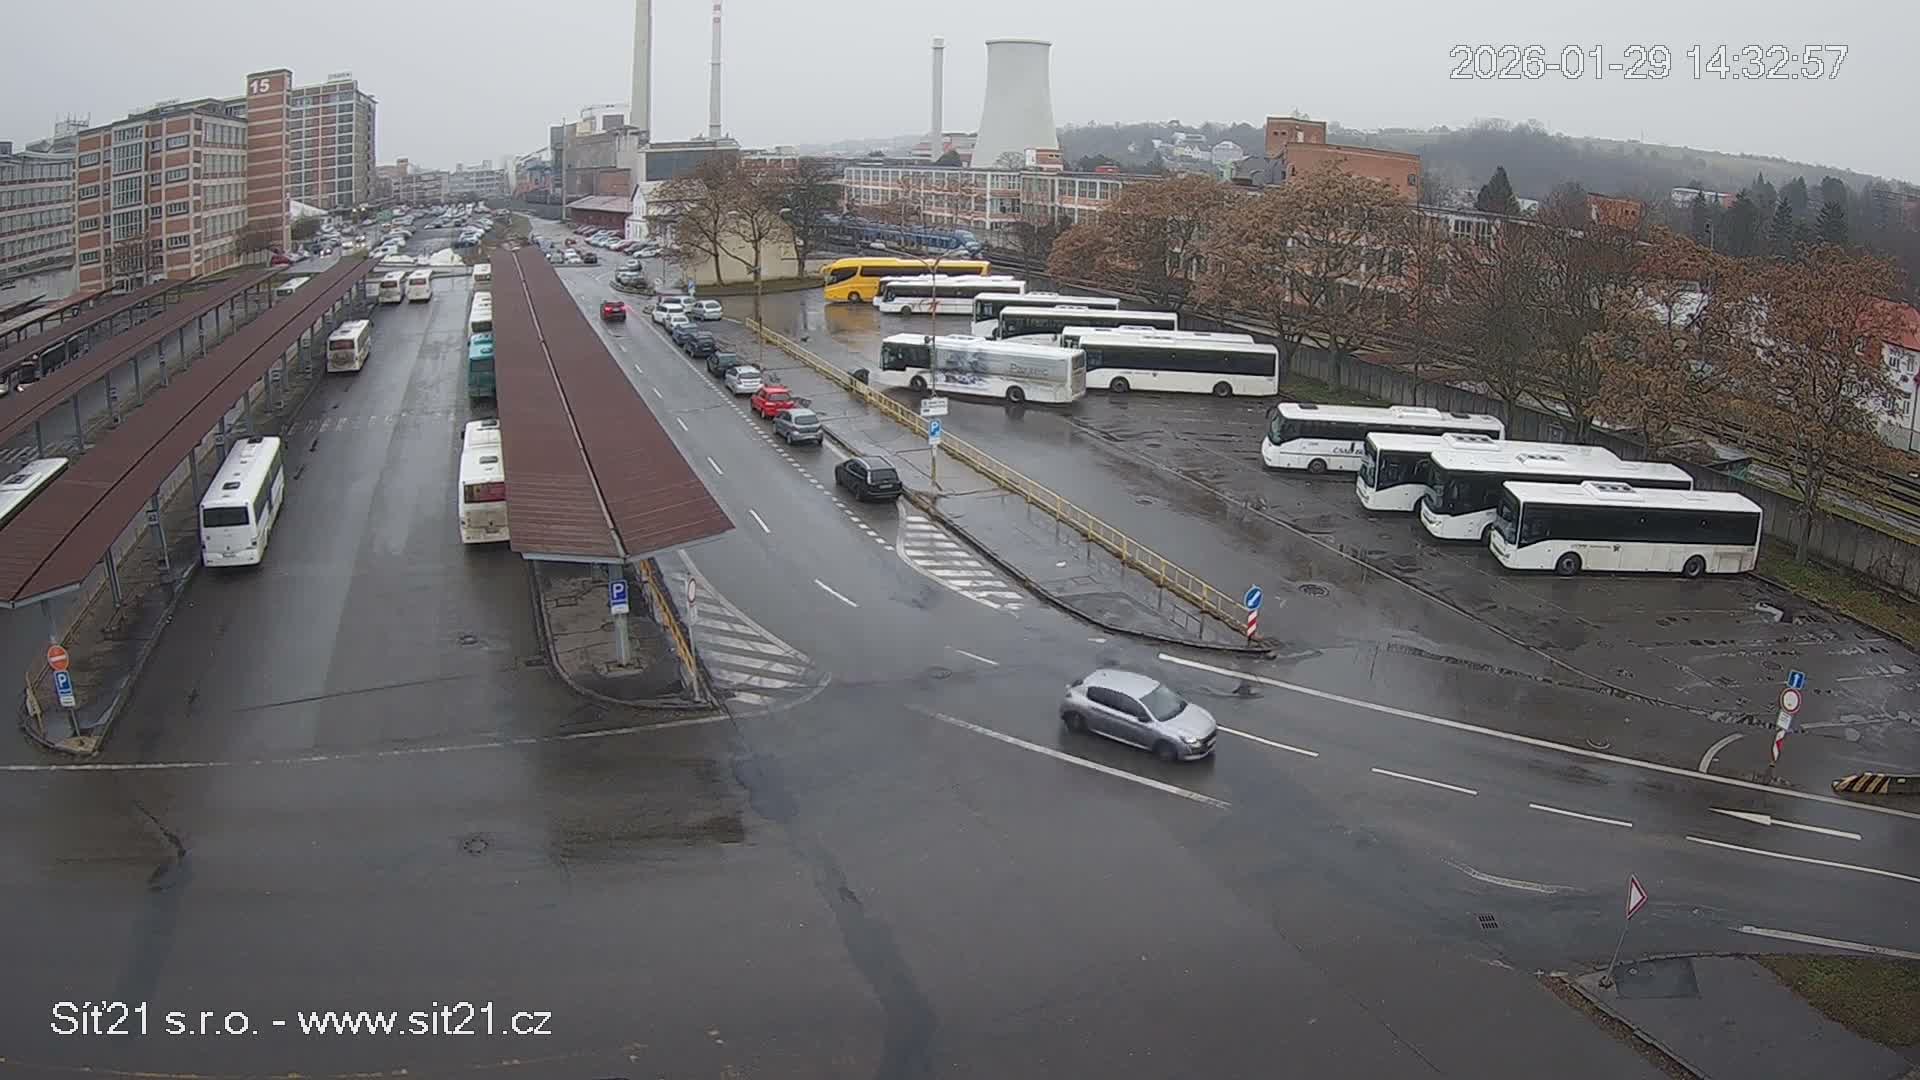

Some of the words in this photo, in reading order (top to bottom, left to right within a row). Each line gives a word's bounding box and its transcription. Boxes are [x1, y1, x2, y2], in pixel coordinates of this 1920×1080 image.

[250, 79, 270, 94] 15
[931, 421, 939, 433] P
[612, 583, 624, 599] P
[57, 673, 67, 689] P
